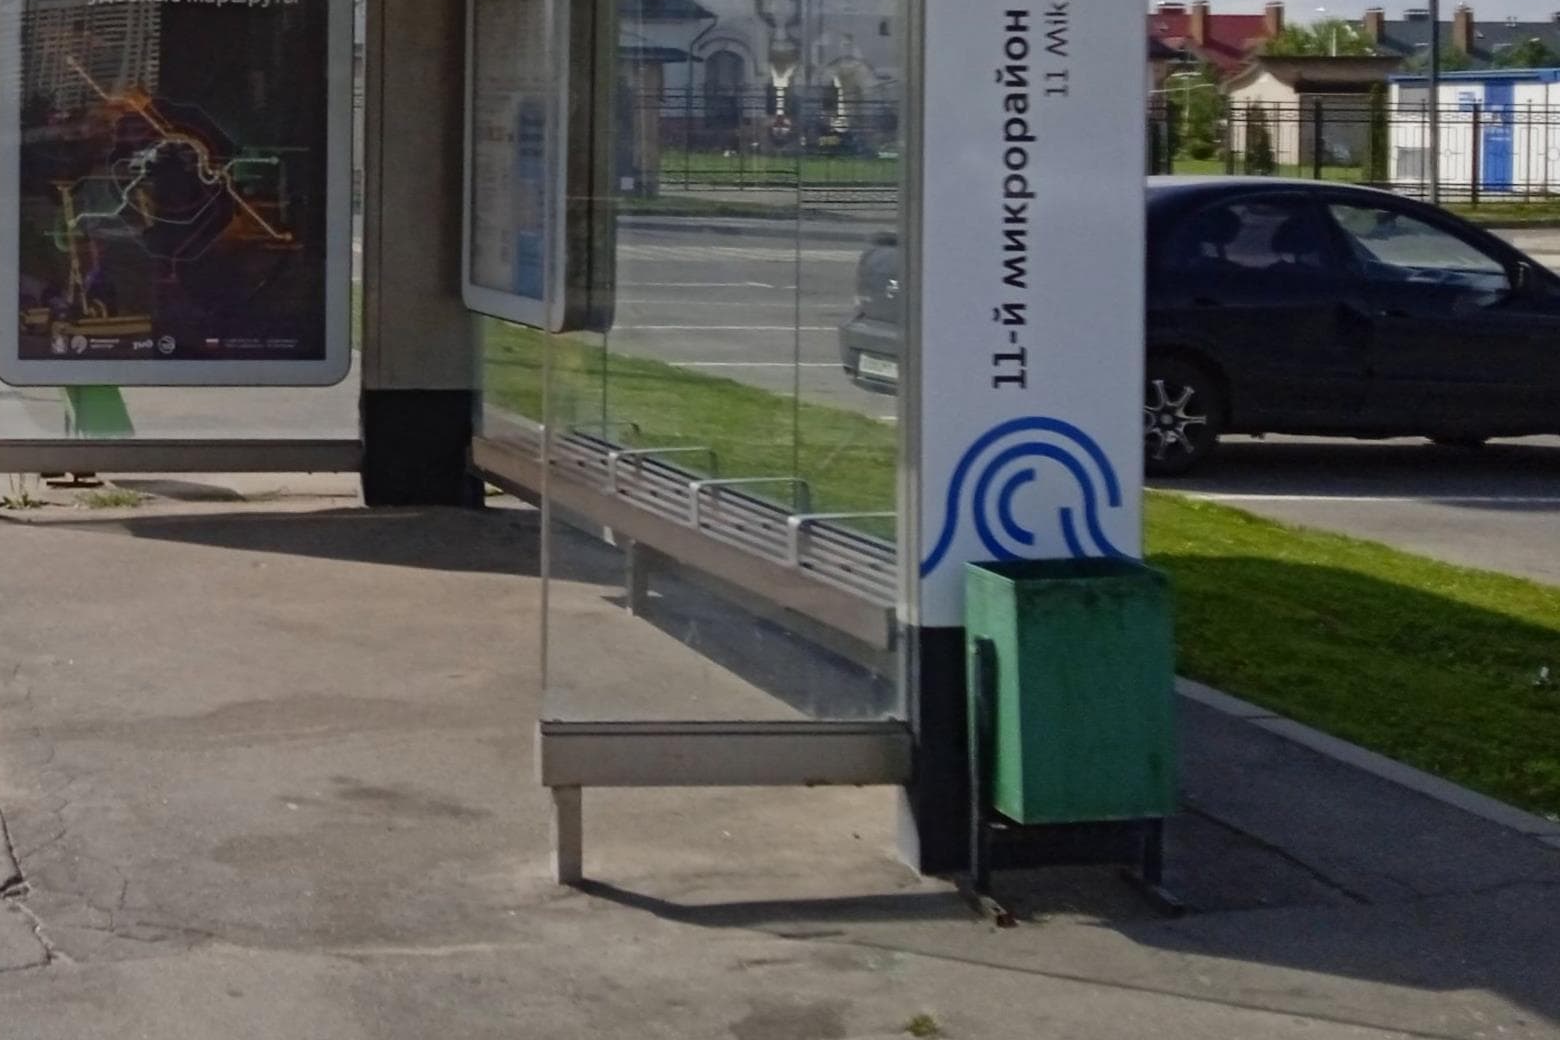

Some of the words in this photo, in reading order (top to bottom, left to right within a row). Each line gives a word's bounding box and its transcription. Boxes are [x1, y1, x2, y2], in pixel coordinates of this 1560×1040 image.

[1044, 70, 1070, 98] 11
[994, 8, 1038, 288] микрорайон
[991, 303, 1029, 391] 11-й
